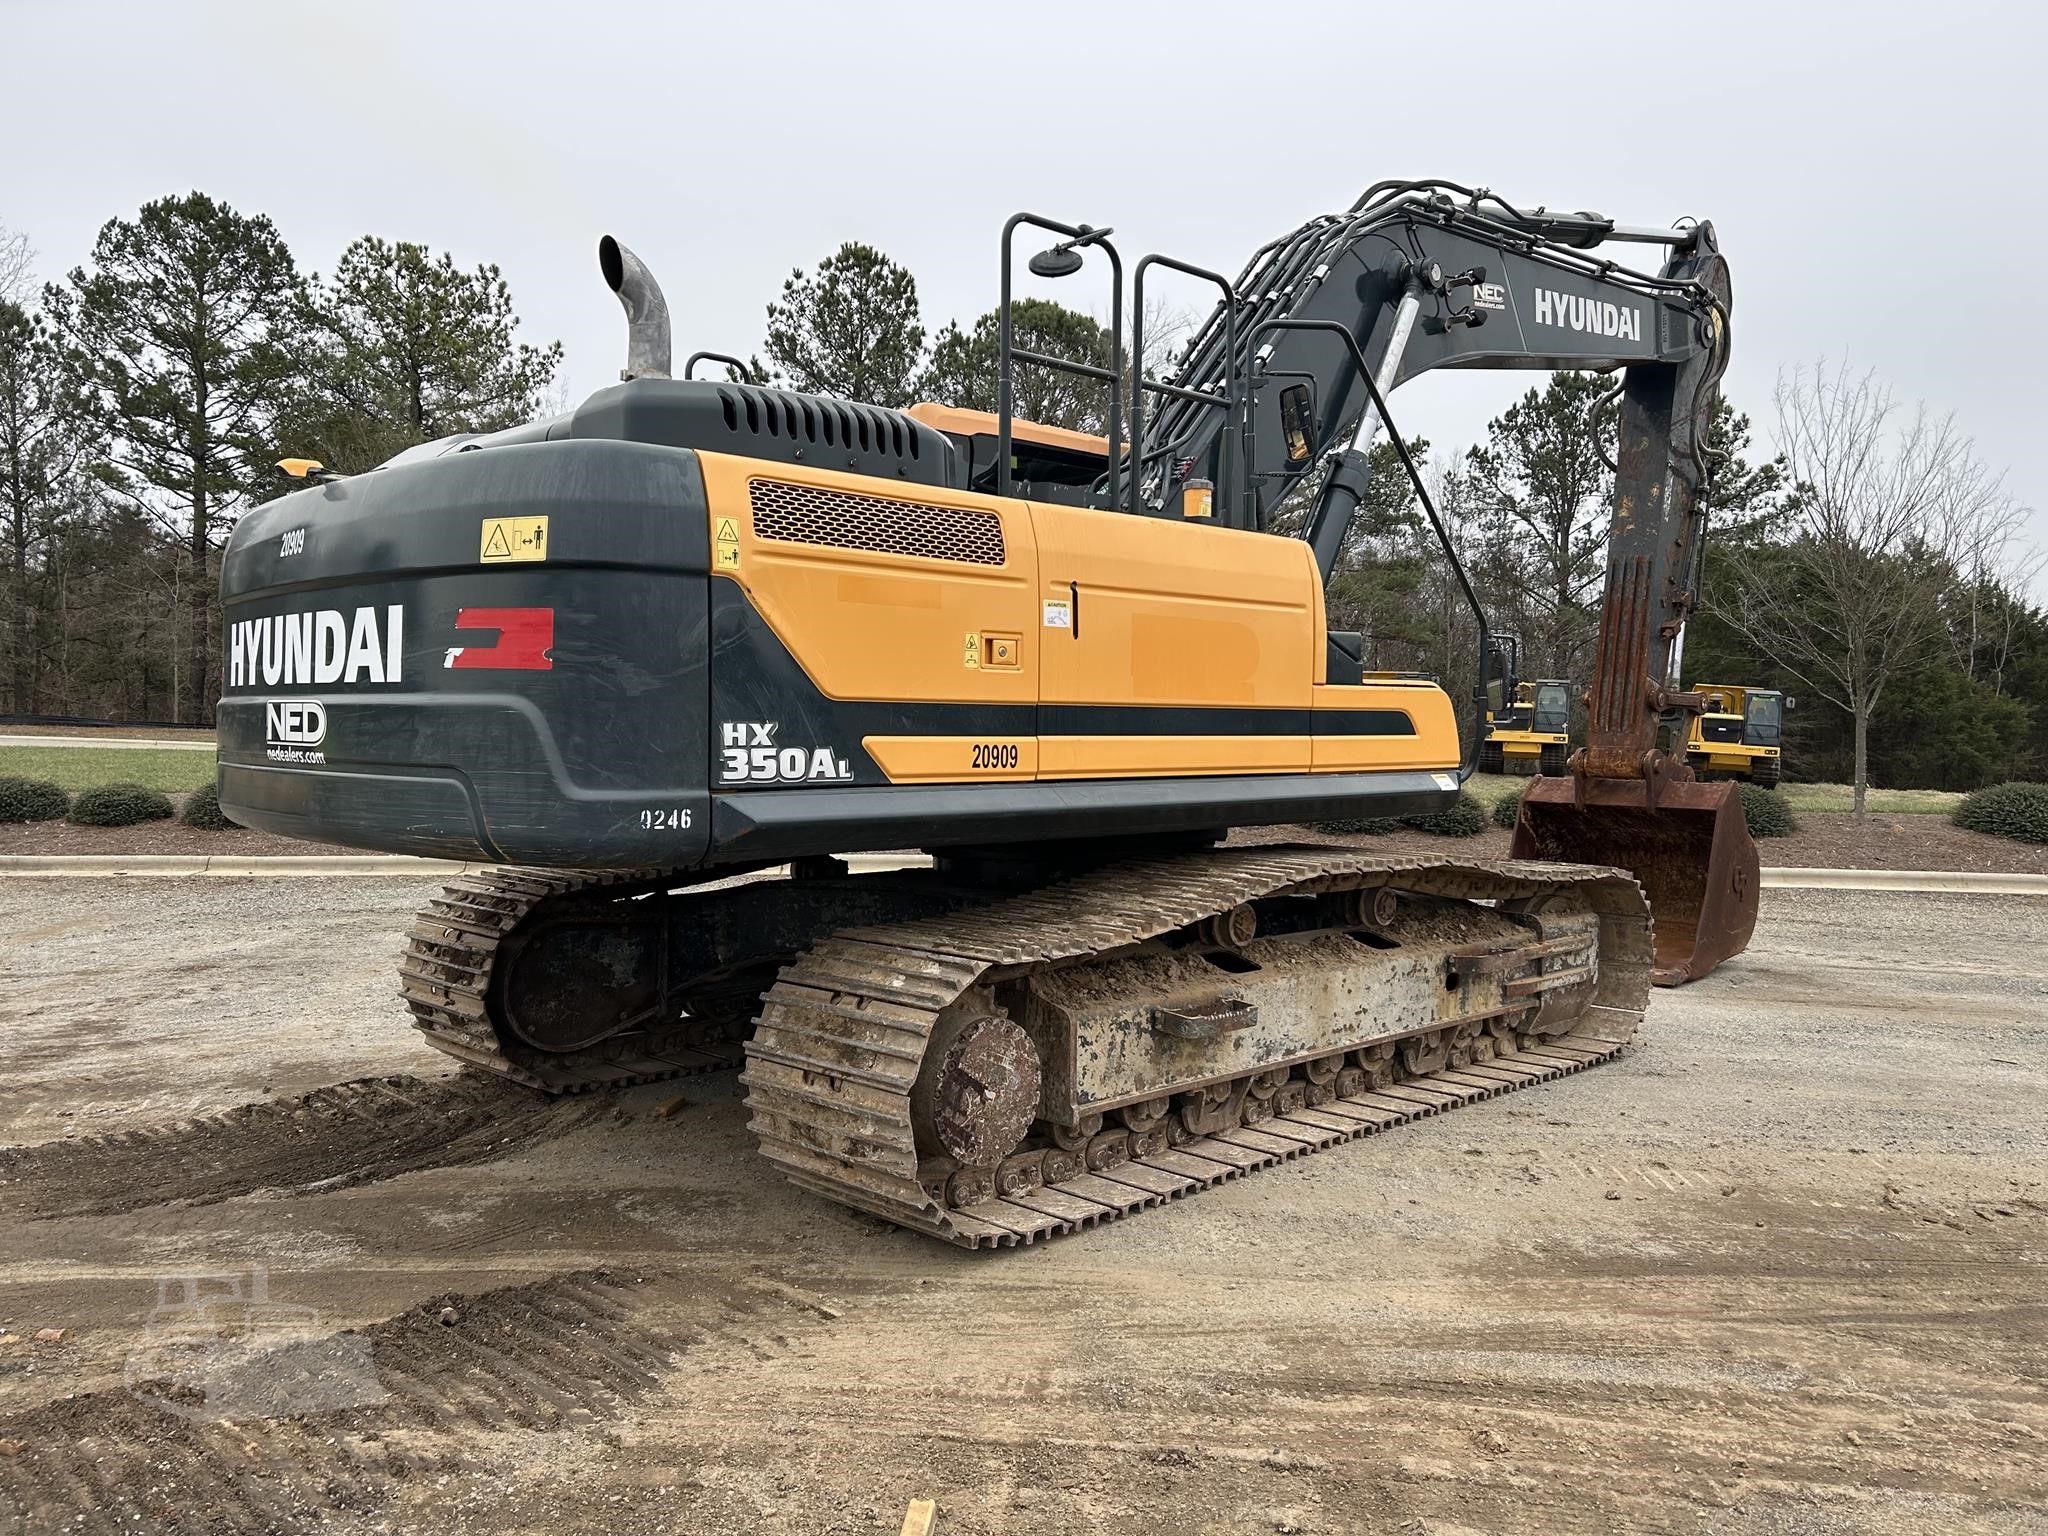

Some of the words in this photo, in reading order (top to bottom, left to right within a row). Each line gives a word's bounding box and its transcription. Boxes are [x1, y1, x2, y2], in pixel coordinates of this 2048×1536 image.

[1535, 287, 1641, 342] HYUNDAI
[280, 528, 305, 557] 20909
[230, 604, 404, 687] HYUNDAI
[266, 702, 326, 743] NED
[722, 721, 775, 747] HX
[266, 746, 326, 765] nedealers.com
[721, 747, 852, 781] 350AL
[972, 744, 1018, 769] 20909
